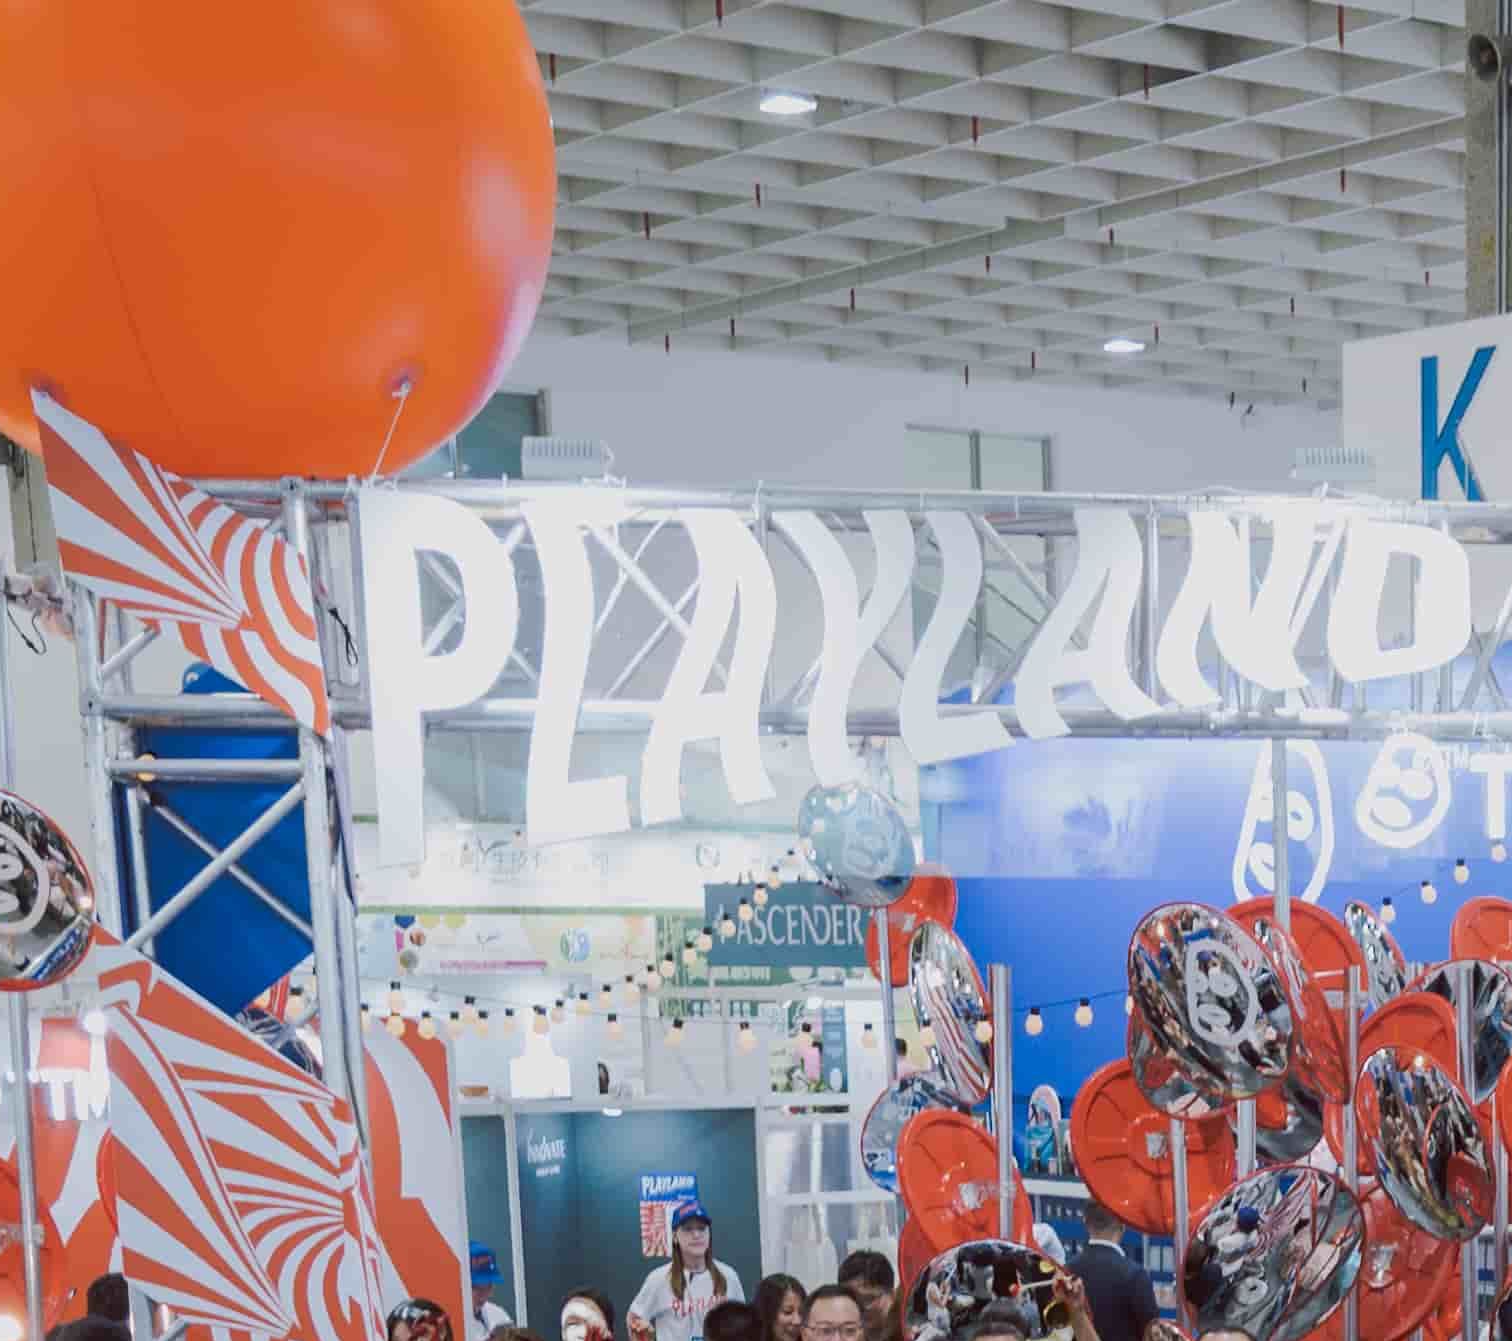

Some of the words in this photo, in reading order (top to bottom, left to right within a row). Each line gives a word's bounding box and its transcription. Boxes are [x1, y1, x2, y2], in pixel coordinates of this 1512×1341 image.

[1420, 345, 1496, 502] K
[360, 488, 1473, 868] PLAYLAND
[735, 905, 864, 947] ASCENDER
